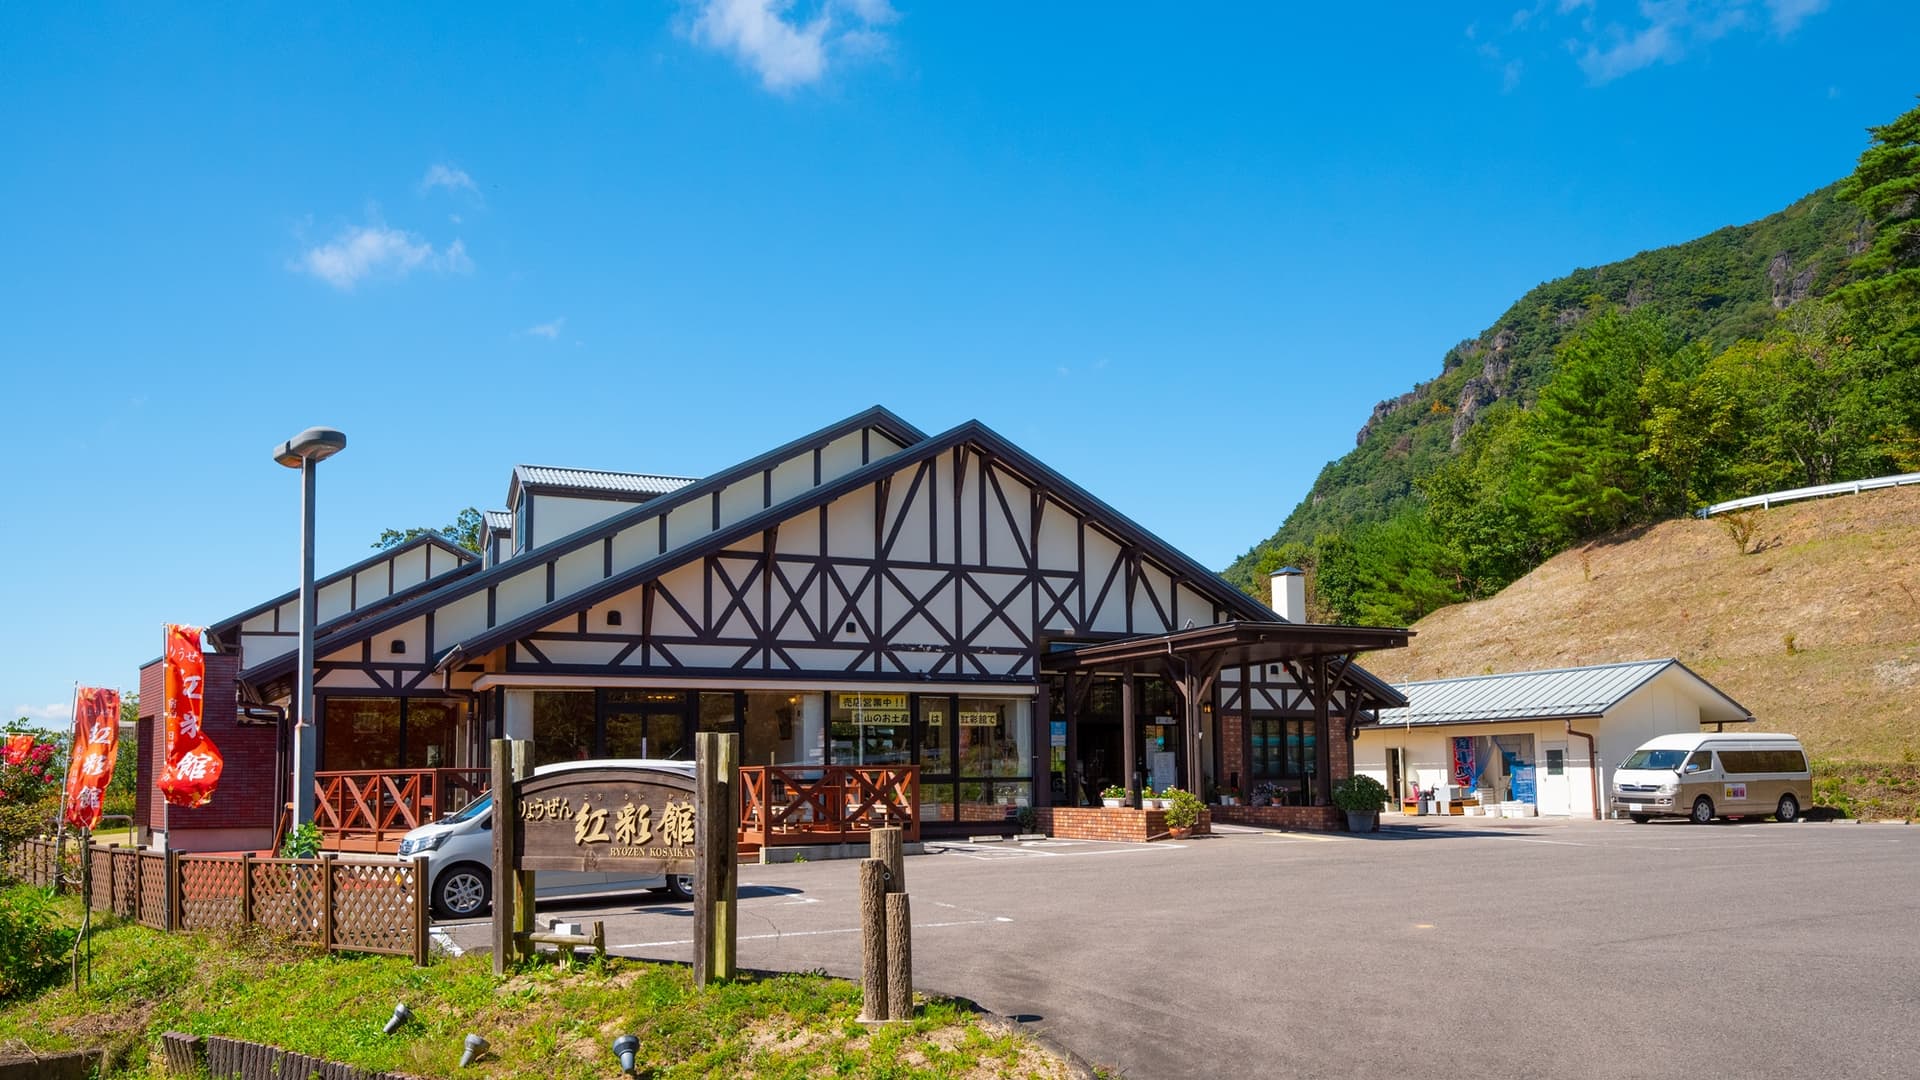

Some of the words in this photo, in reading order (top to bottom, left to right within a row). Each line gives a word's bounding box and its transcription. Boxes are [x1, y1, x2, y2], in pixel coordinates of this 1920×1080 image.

[930, 713, 940, 723] は
[575, 801, 696, 846] 紅彩館
[610, 847, 646, 857] RYOZEN
[649, 847, 696, 858] KOSAIKAN
